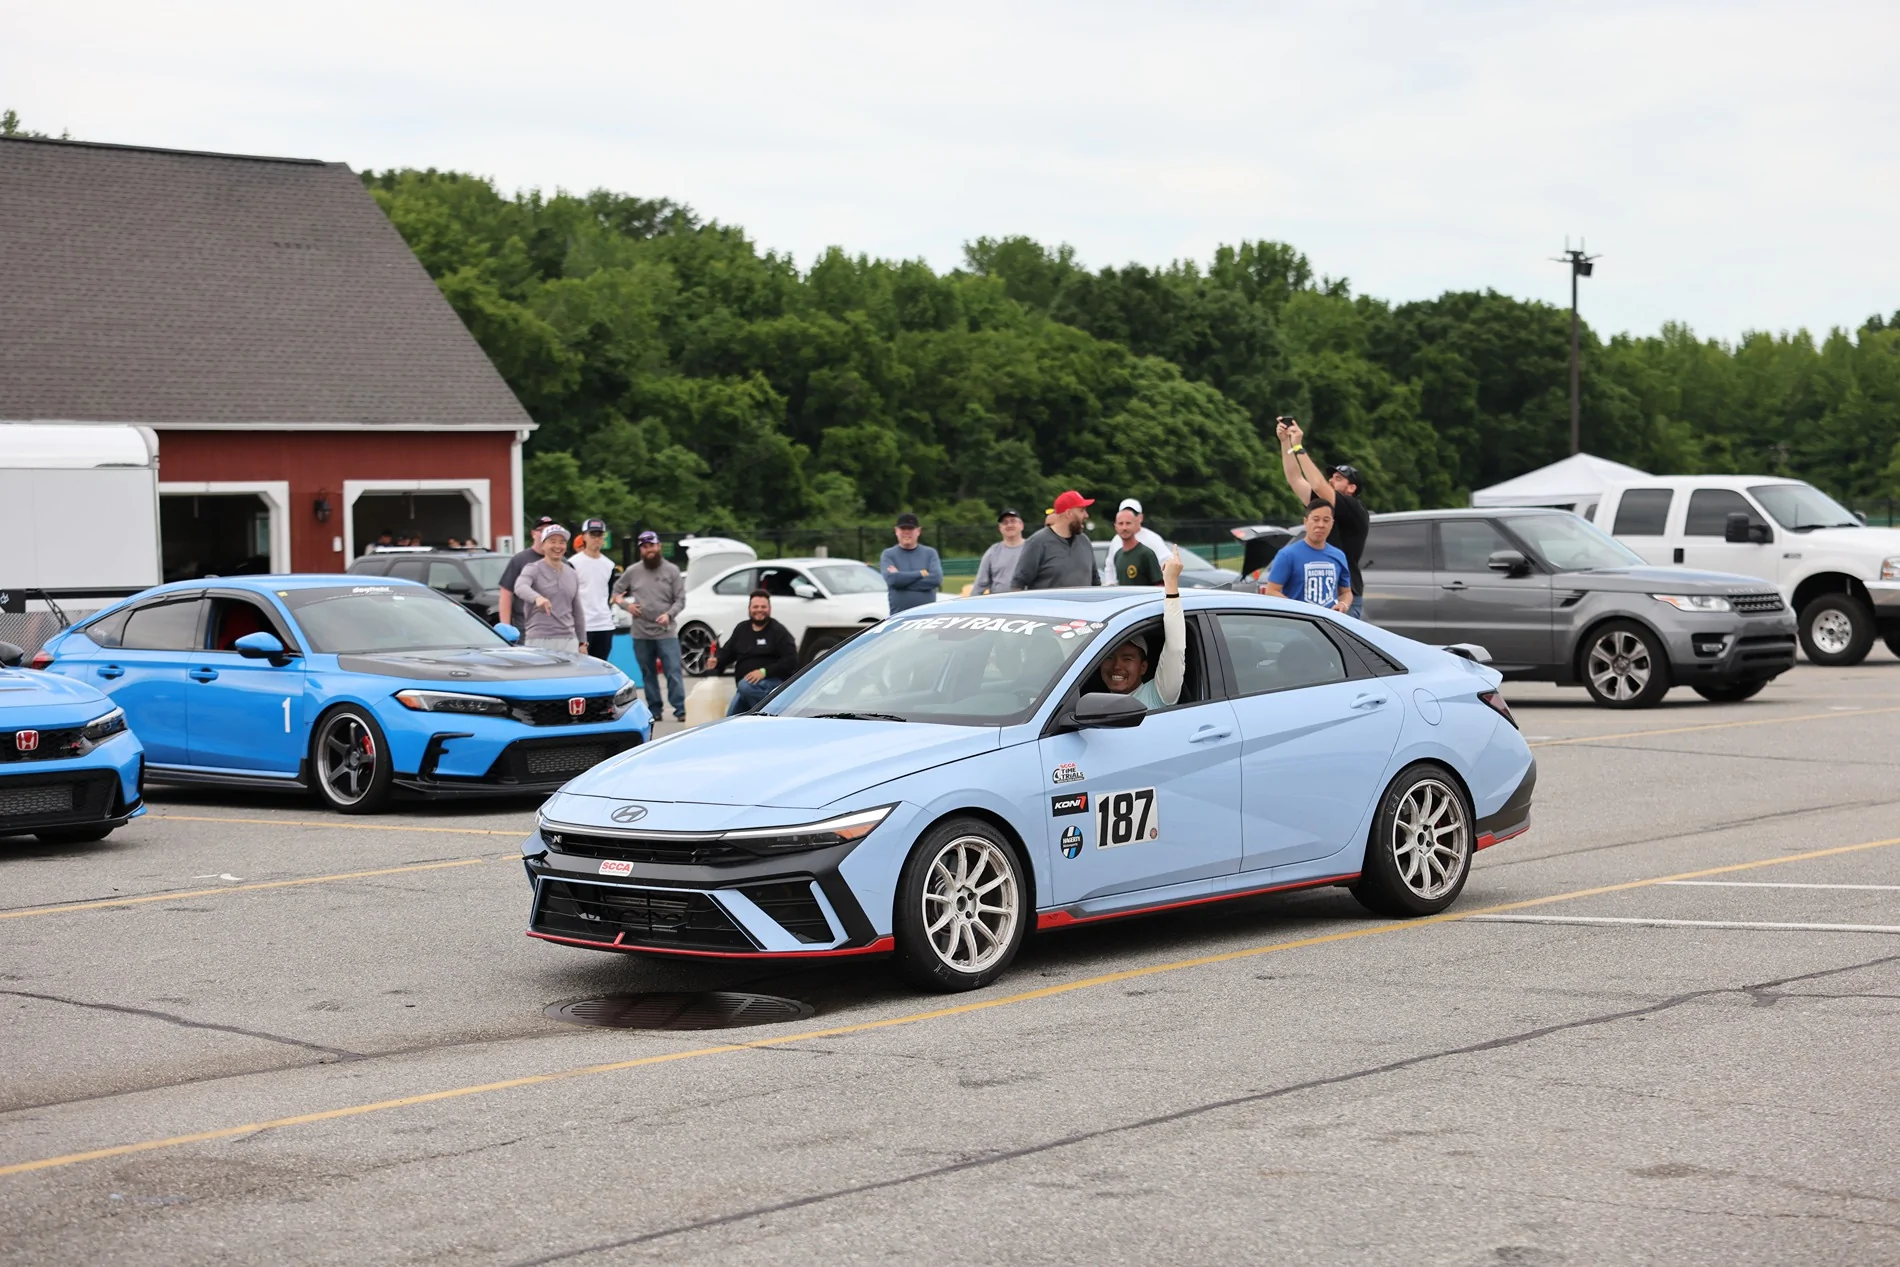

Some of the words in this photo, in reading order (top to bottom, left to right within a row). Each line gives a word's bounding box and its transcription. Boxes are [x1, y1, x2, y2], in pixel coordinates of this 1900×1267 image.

[1308, 576, 1334, 605] ALS
[893, 617, 1048, 636] TREYRACK
[281, 696, 291, 733] 1
[1054, 800, 1081, 809] KONI
[1098, 789, 1154, 847] 187
[601, 862, 631, 871] SCCA
